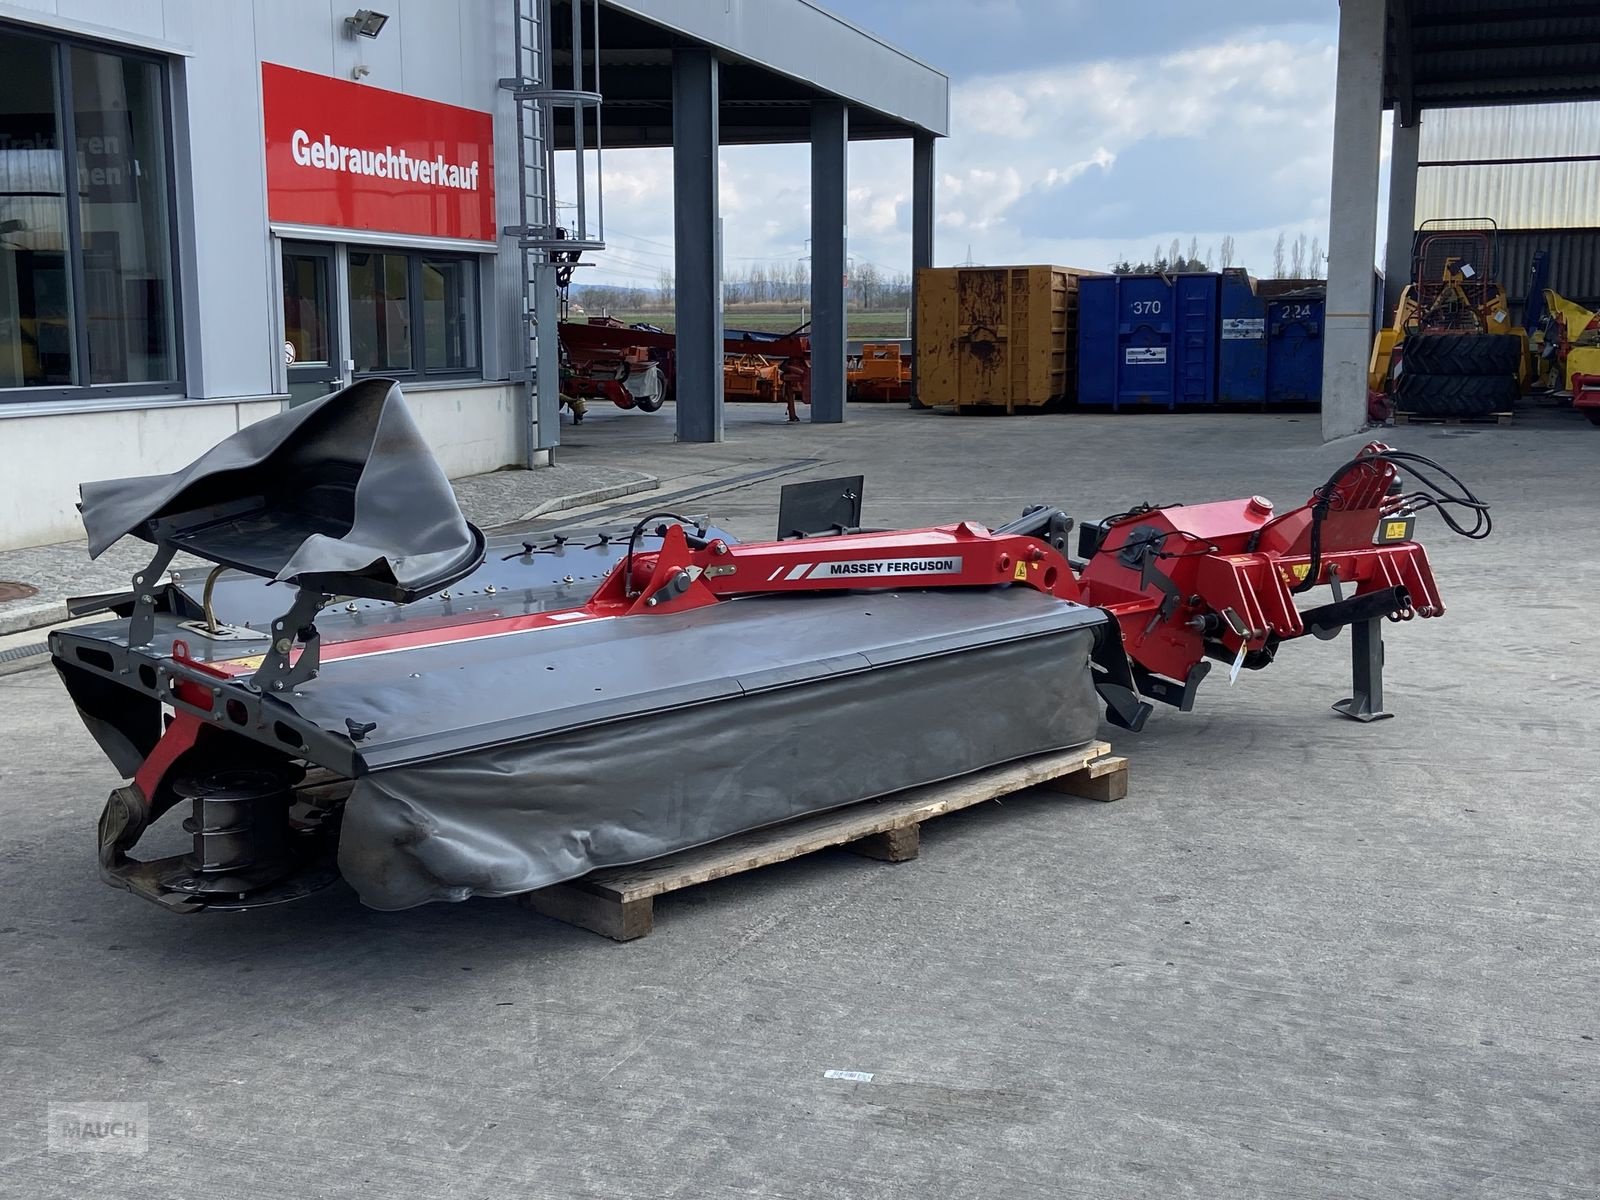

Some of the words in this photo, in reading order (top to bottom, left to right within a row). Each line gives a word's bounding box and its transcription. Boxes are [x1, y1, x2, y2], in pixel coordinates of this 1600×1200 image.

[292, 129, 479, 191] Gebrauchtverkauf
[1133, 300, 1161, 315] 370
[830, 562, 883, 575] MASSEY
[887, 560, 953, 573] FERGUSON
